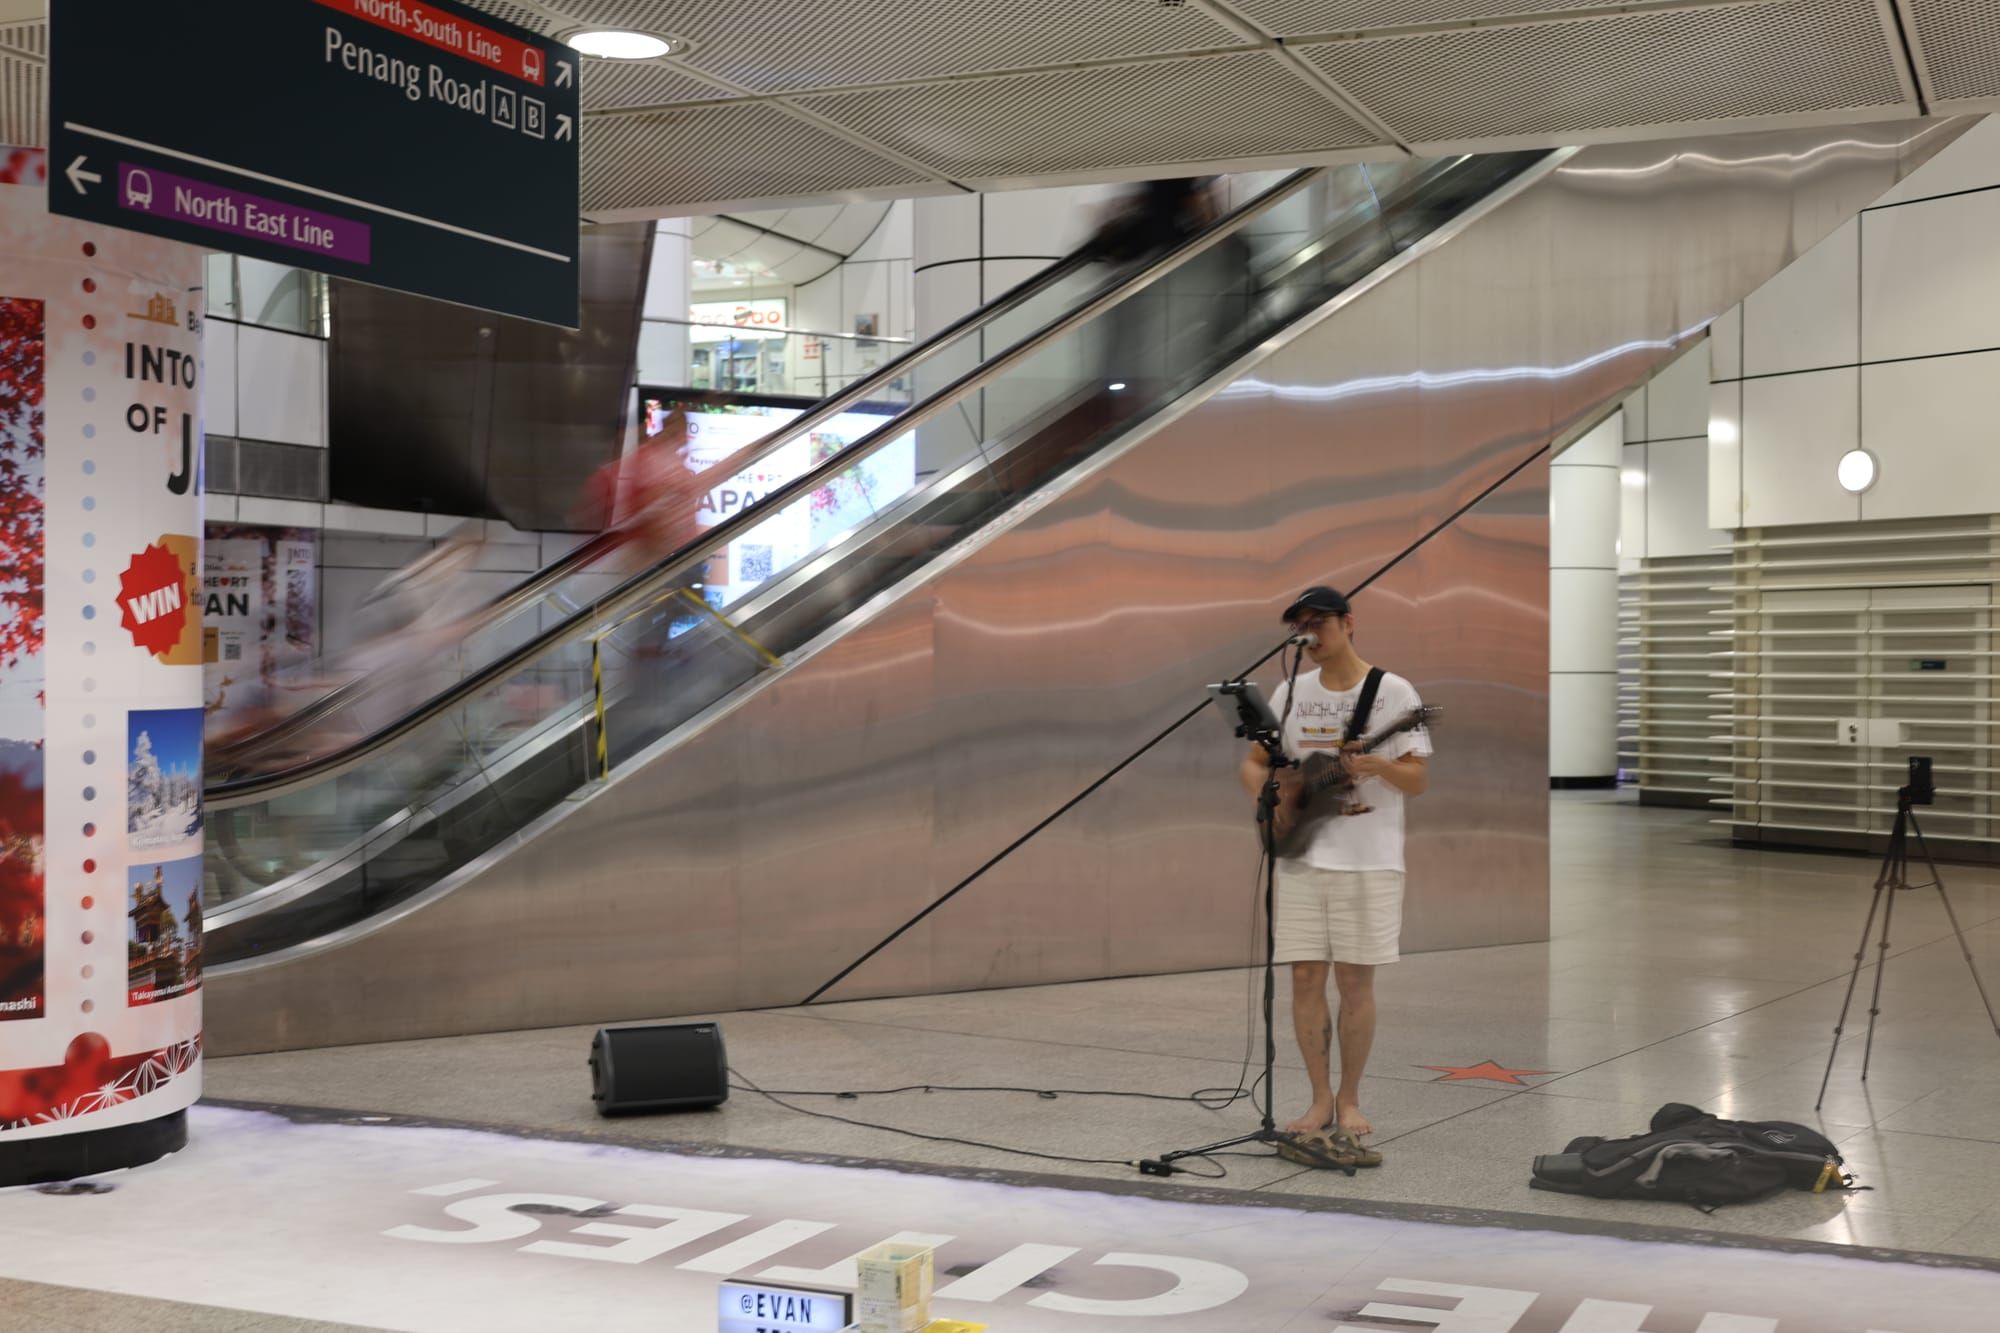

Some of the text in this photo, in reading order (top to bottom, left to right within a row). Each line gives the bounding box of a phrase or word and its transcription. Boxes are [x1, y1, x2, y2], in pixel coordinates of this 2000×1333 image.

[467, 31, 502, 63] Line
[325, 27, 421, 101] Penang
[428, 64, 486, 116] Road
[175, 185, 335, 249] North East Line
[126, 342, 196, 389] INTO
[126, 403, 168, 434] OF
[127, 582, 182, 625] WIN
[741, 1293, 812, 1324] @EVAN
